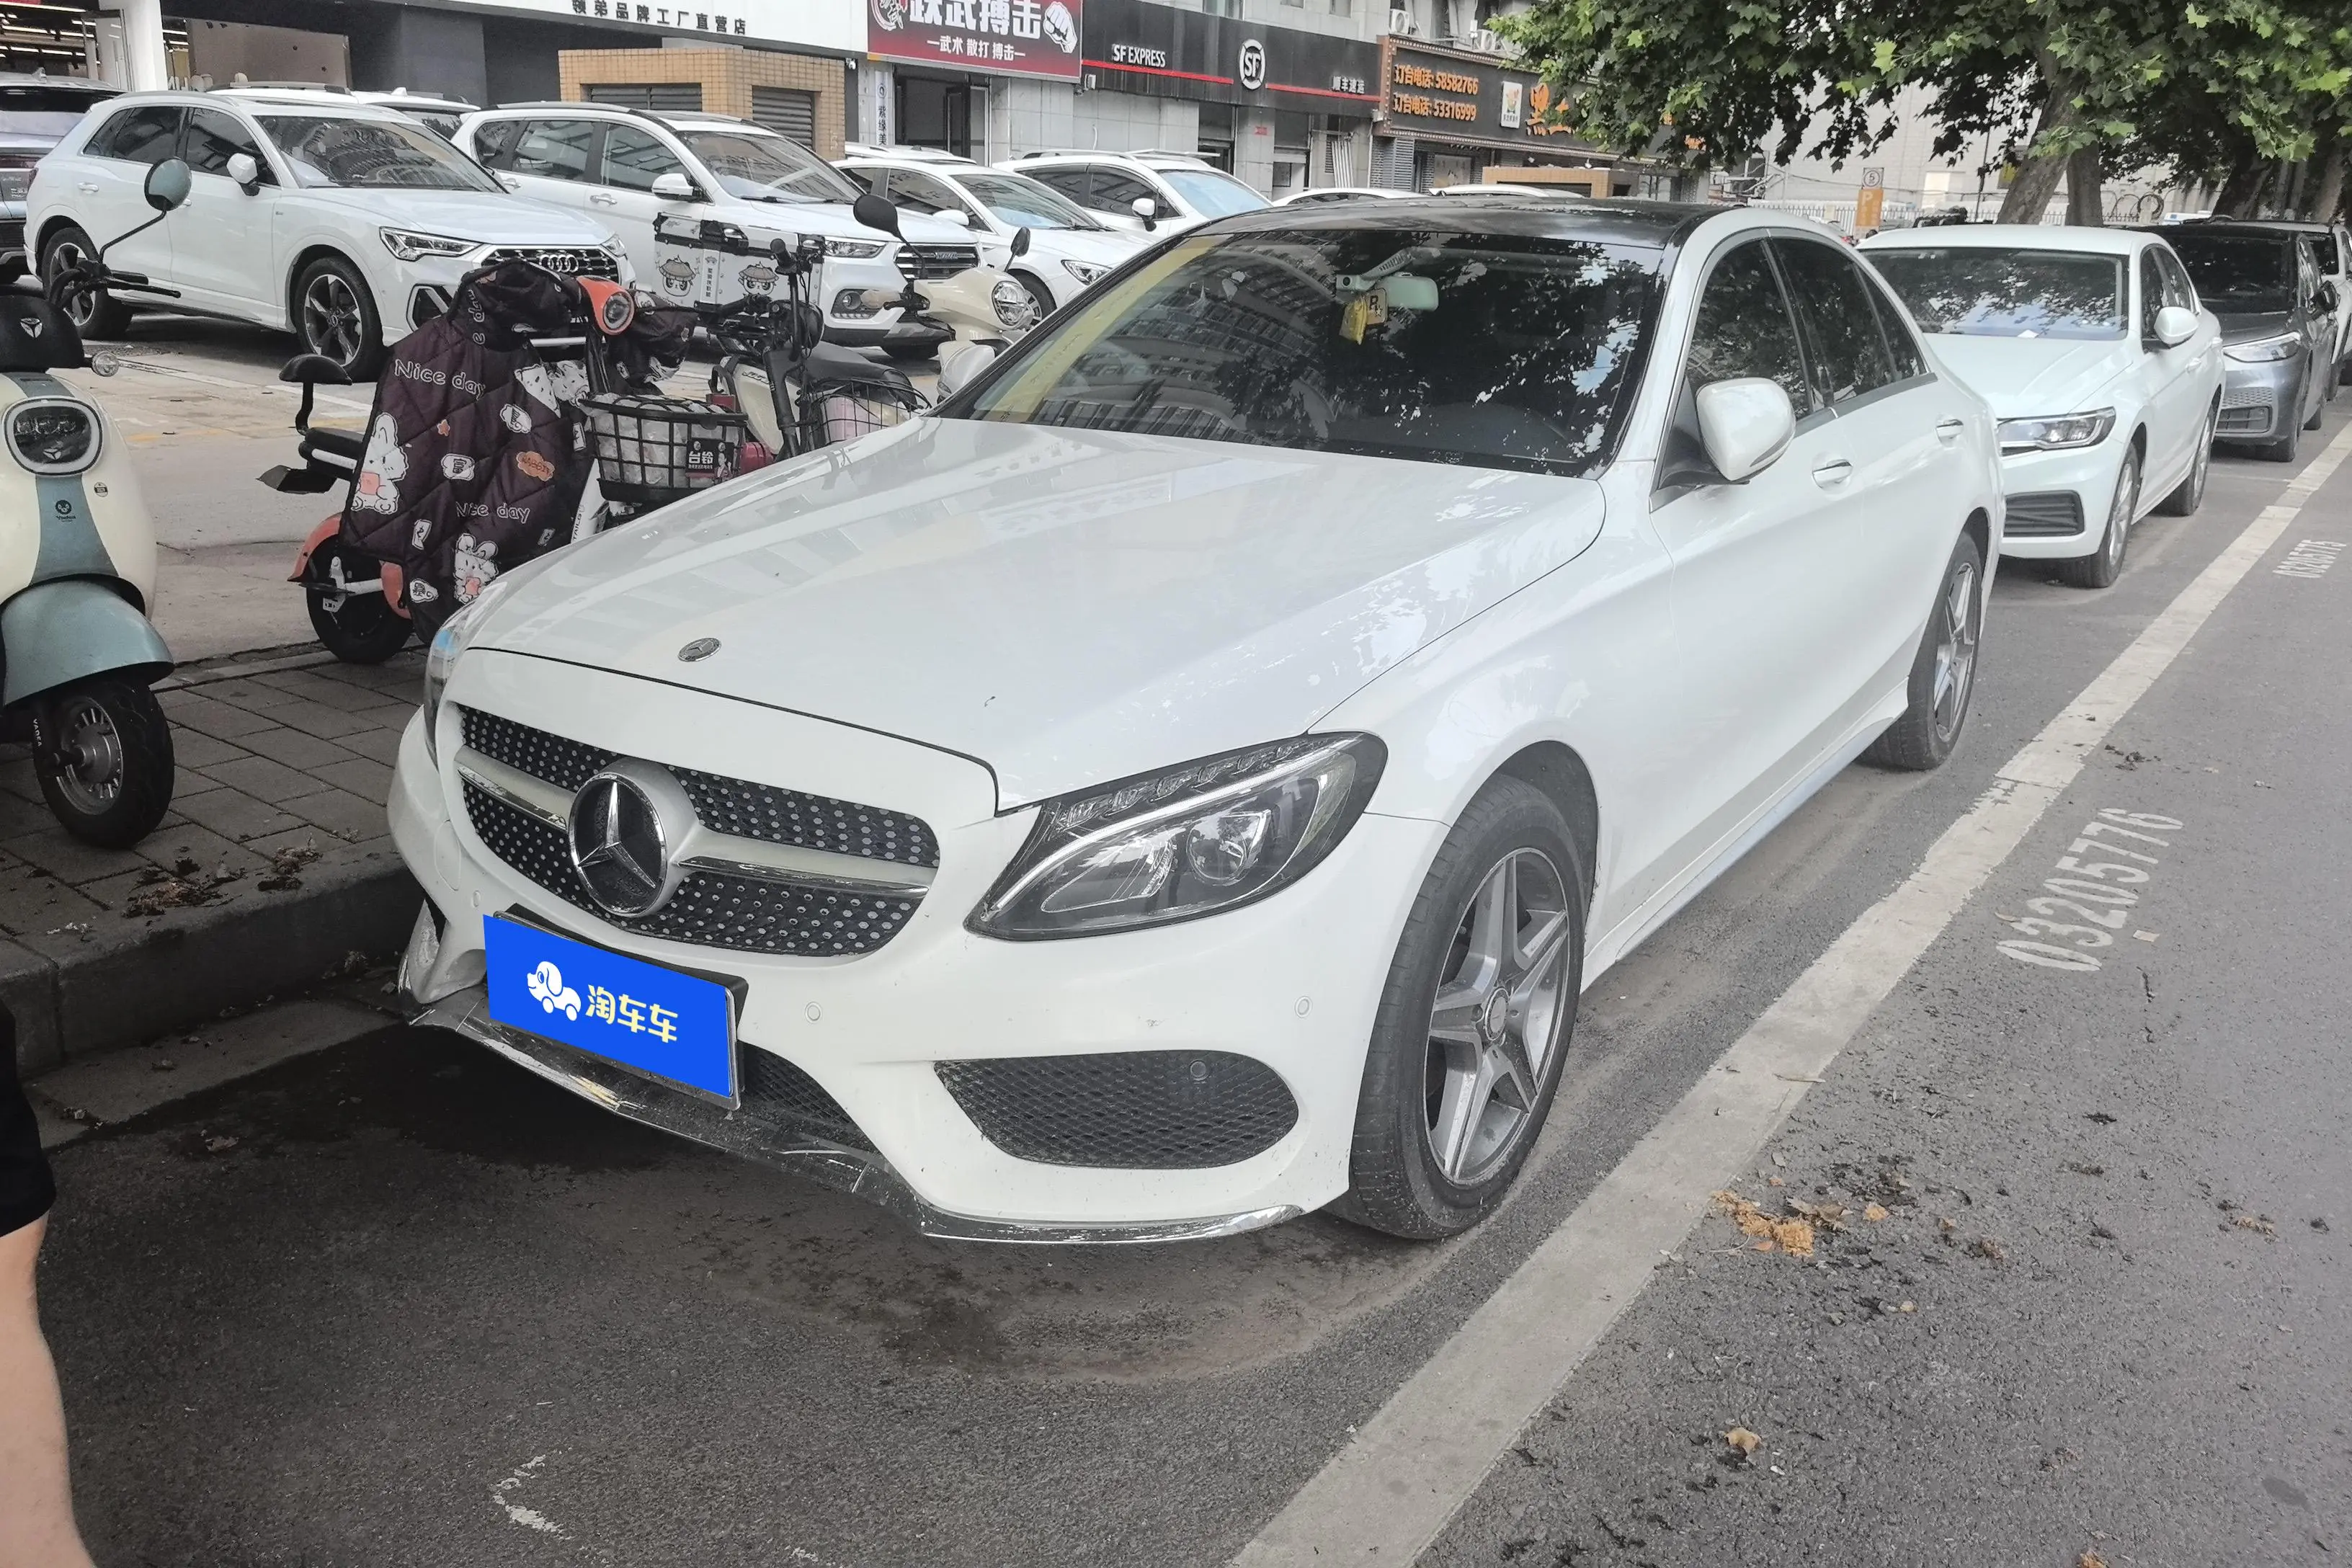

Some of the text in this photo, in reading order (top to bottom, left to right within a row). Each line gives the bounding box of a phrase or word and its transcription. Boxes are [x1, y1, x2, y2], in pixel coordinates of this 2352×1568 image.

[940, 35, 1015, 61] 武术 散打 搏击
[1113, 44, 1166, 68] SF EXPRESS
[1244, 53, 1261, 77] SF
[1332, 76, 1365, 94] 顺丰速运
[395, 359, 486, 401] Nice day
[688, 451, 713, 464] 台铃
[497, 502, 530, 524] day
[1995, 808, 2184, 971] 03205776
